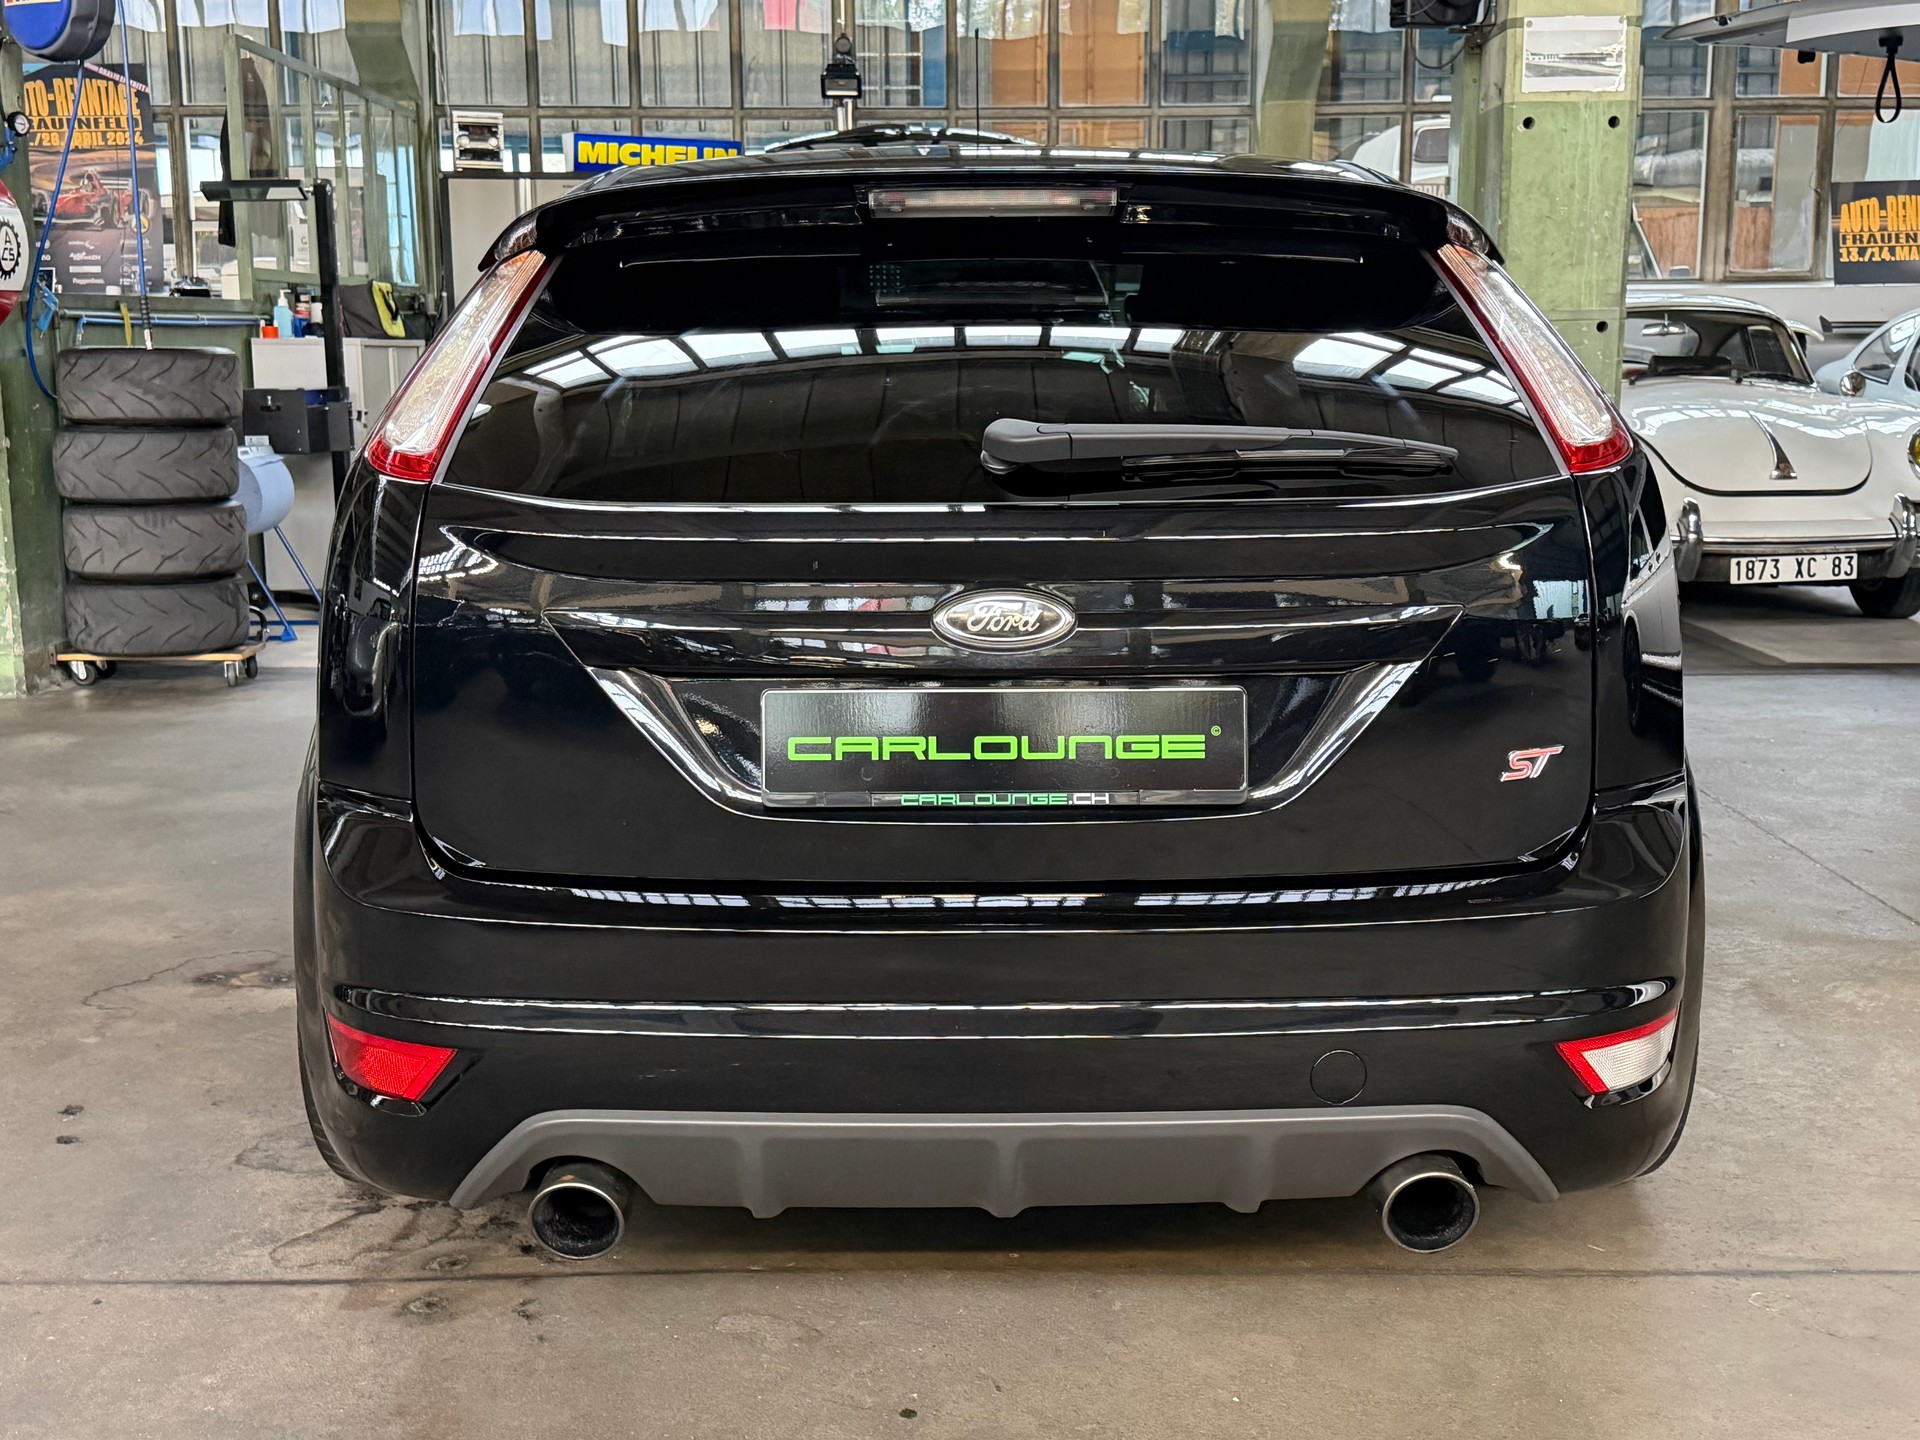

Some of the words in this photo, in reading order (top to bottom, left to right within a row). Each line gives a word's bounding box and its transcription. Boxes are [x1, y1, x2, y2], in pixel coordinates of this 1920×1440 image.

[24, 77, 141, 117] TO-RENNTAGE
[1735, 559, 1780, 581] 1873
[1795, 557, 1817, 579] XC
[1832, 556, 1854, 577] 83
[967, 602, 1043, 632] Ford
[787, 735, 1206, 761] CARLOUNGE
[1501, 745, 1564, 782] ST
